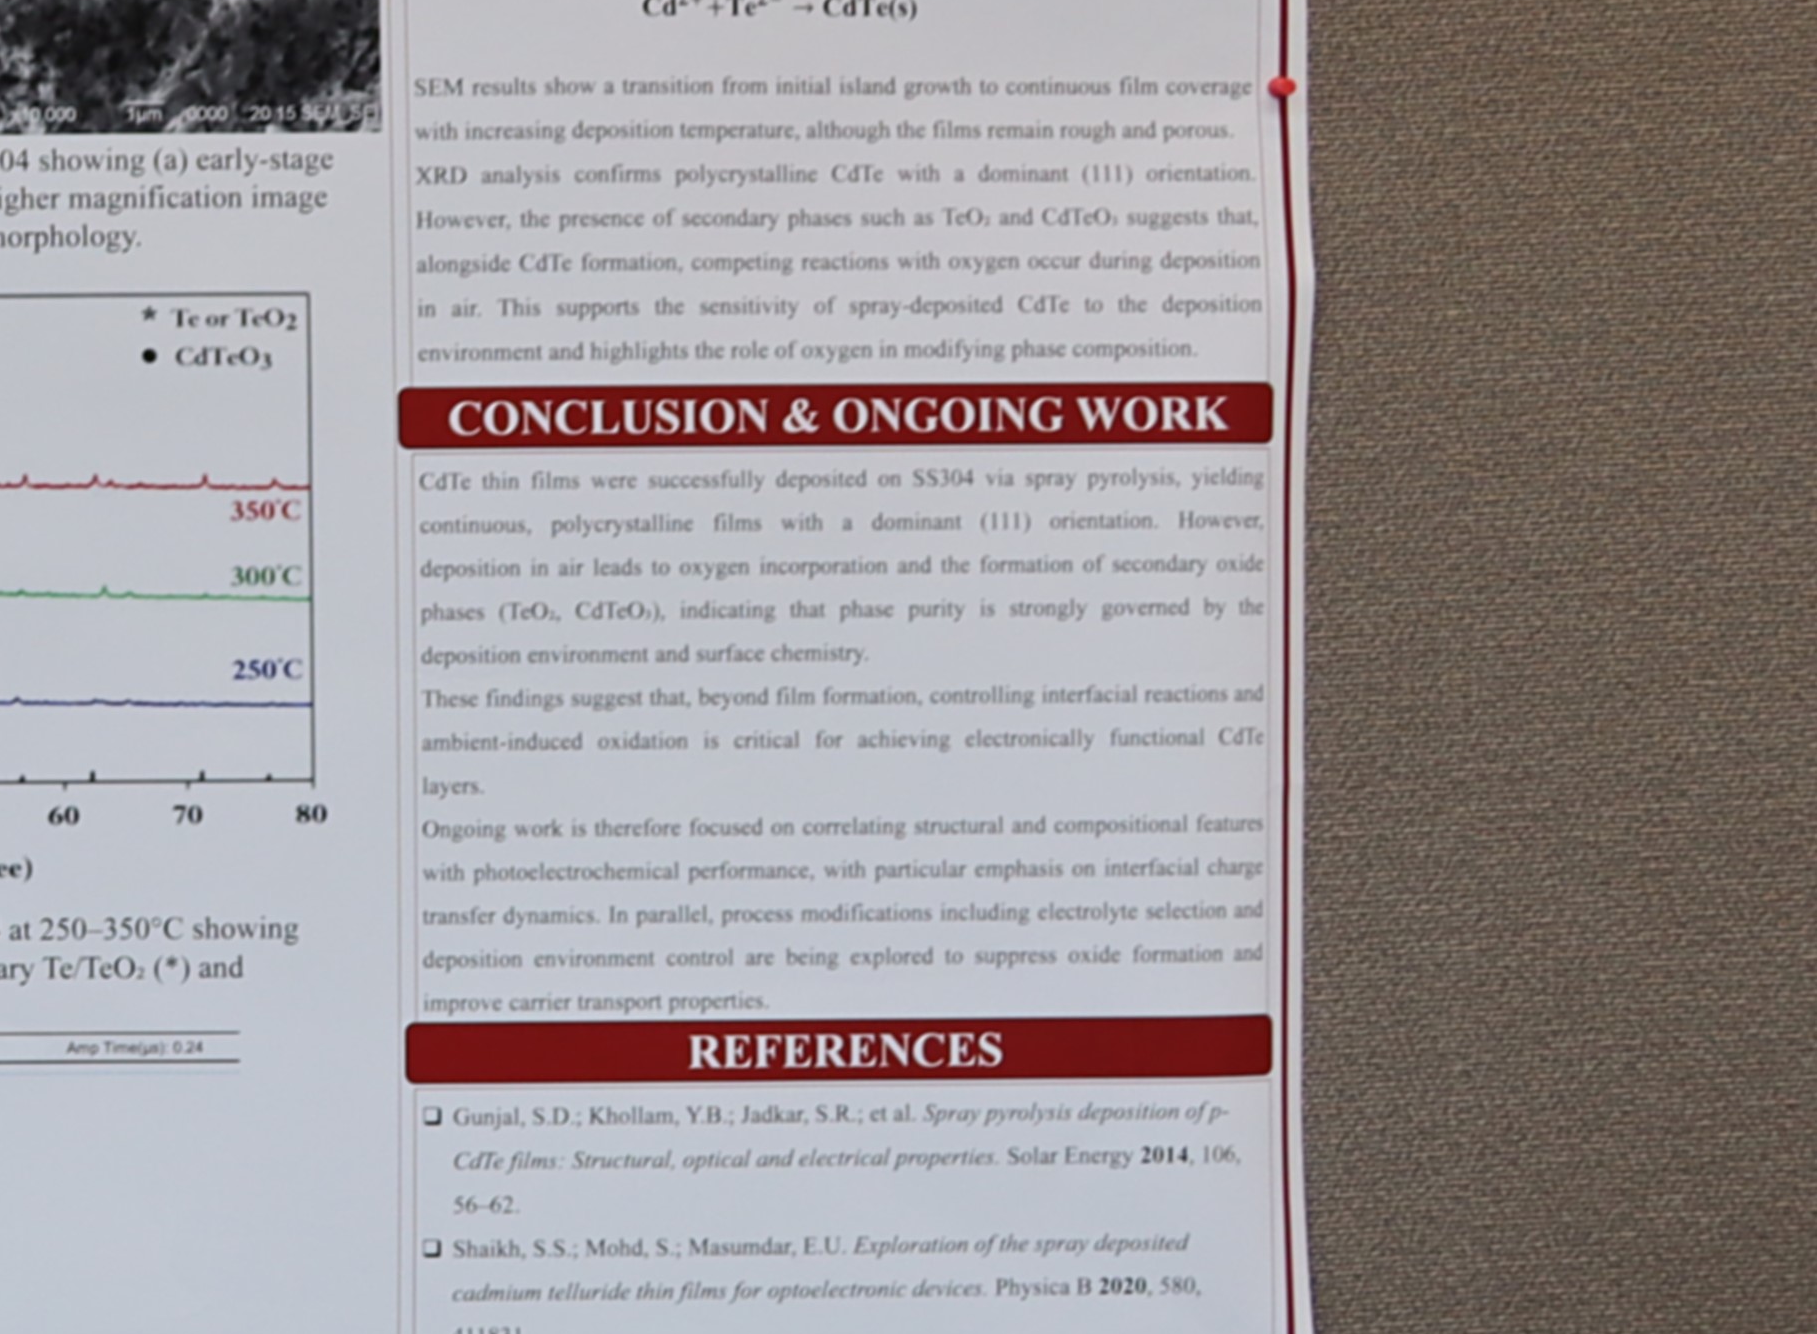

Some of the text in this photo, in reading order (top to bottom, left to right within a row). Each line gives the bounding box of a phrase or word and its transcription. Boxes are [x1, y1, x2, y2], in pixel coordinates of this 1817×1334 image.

[449, 396, 1229, 438] CONCLUSION & ONGOING WORK
[48, 806, 82, 827] 60
[173, 804, 205, 826] 70
[296, 804, 330, 826] 80
[691, 1031, 1004, 1071] REFERENCES
